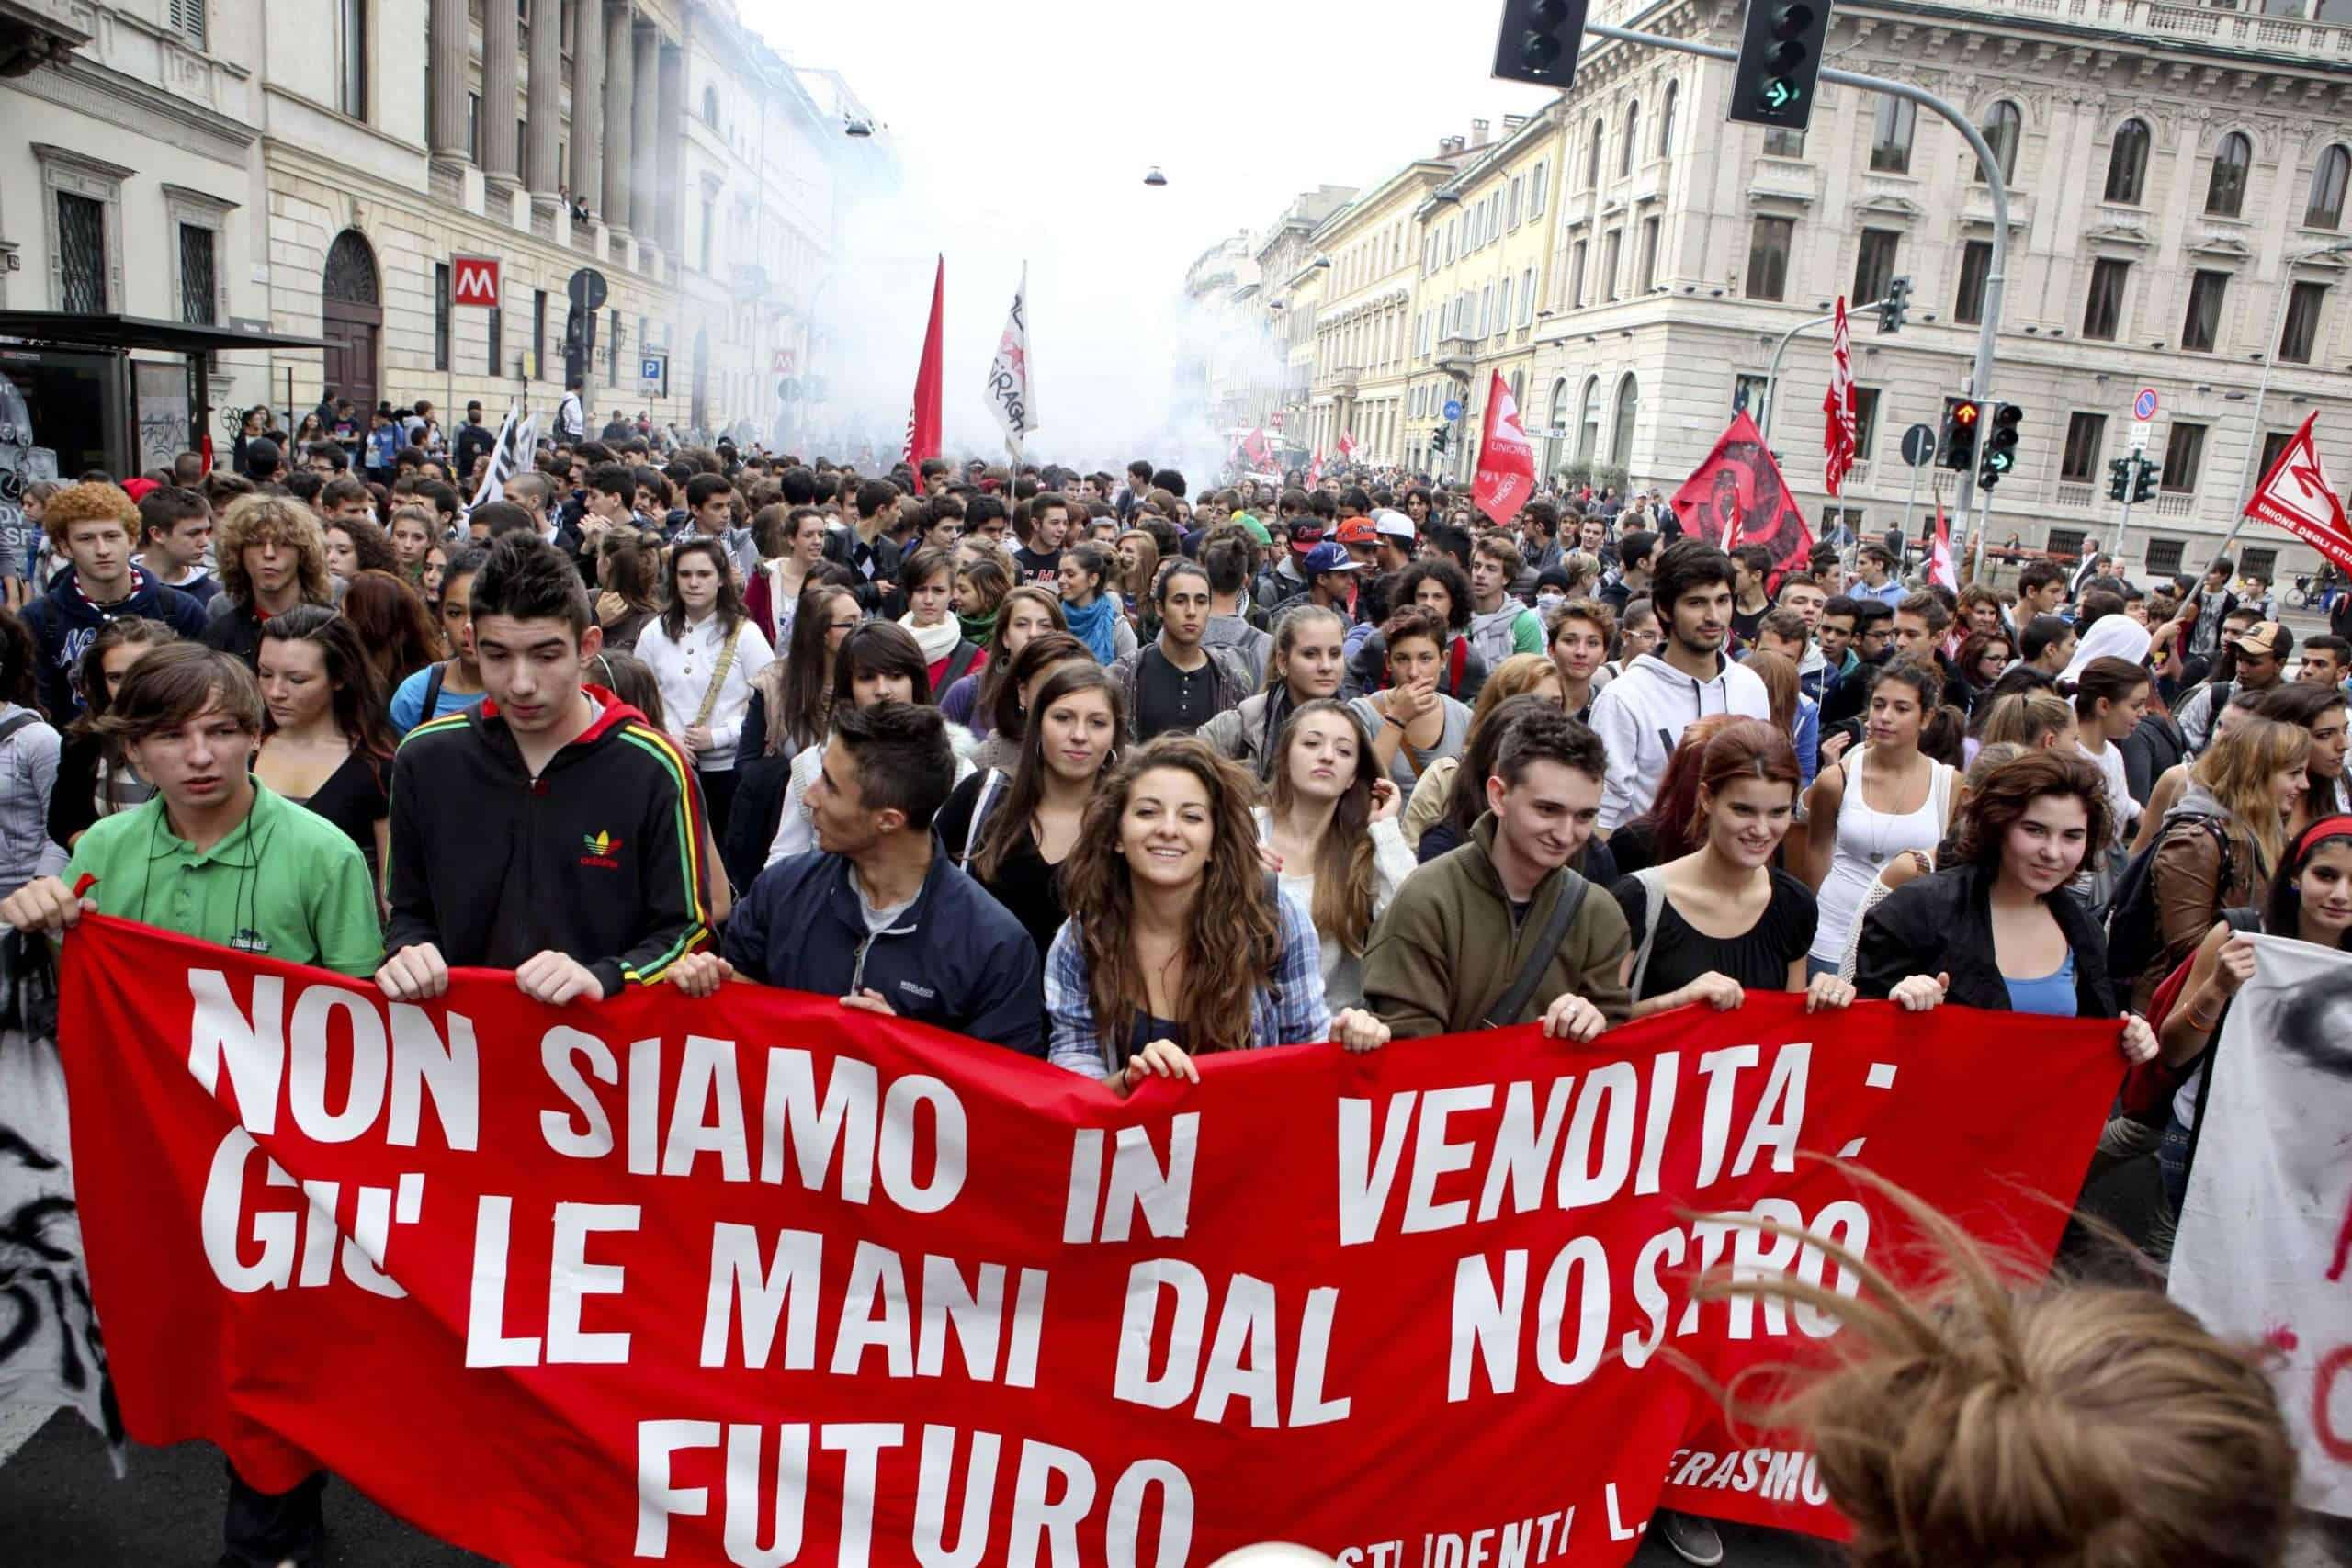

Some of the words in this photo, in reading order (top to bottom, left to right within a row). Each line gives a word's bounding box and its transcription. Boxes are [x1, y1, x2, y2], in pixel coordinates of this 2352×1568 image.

[457, 267, 496, 299] M
[2258, 503, 2296, 530] UNIONE
[2297, 526, 2330, 548] DEGLI
[2331, 545, 2352, 565] STU
[188, 969, 479, 1151] NON
[540, 1025, 967, 1213] SIAMO
[1063, 1112, 1200, 1243] IN
[466, 1195, 641, 1368] LE
[700, 1222, 1047, 1388] MANI
[1114, 1258, 1351, 1428] DAL
[1447, 1198, 1870, 1402] NOSTRO
[634, 1419, 1193, 1568] FUTURO
